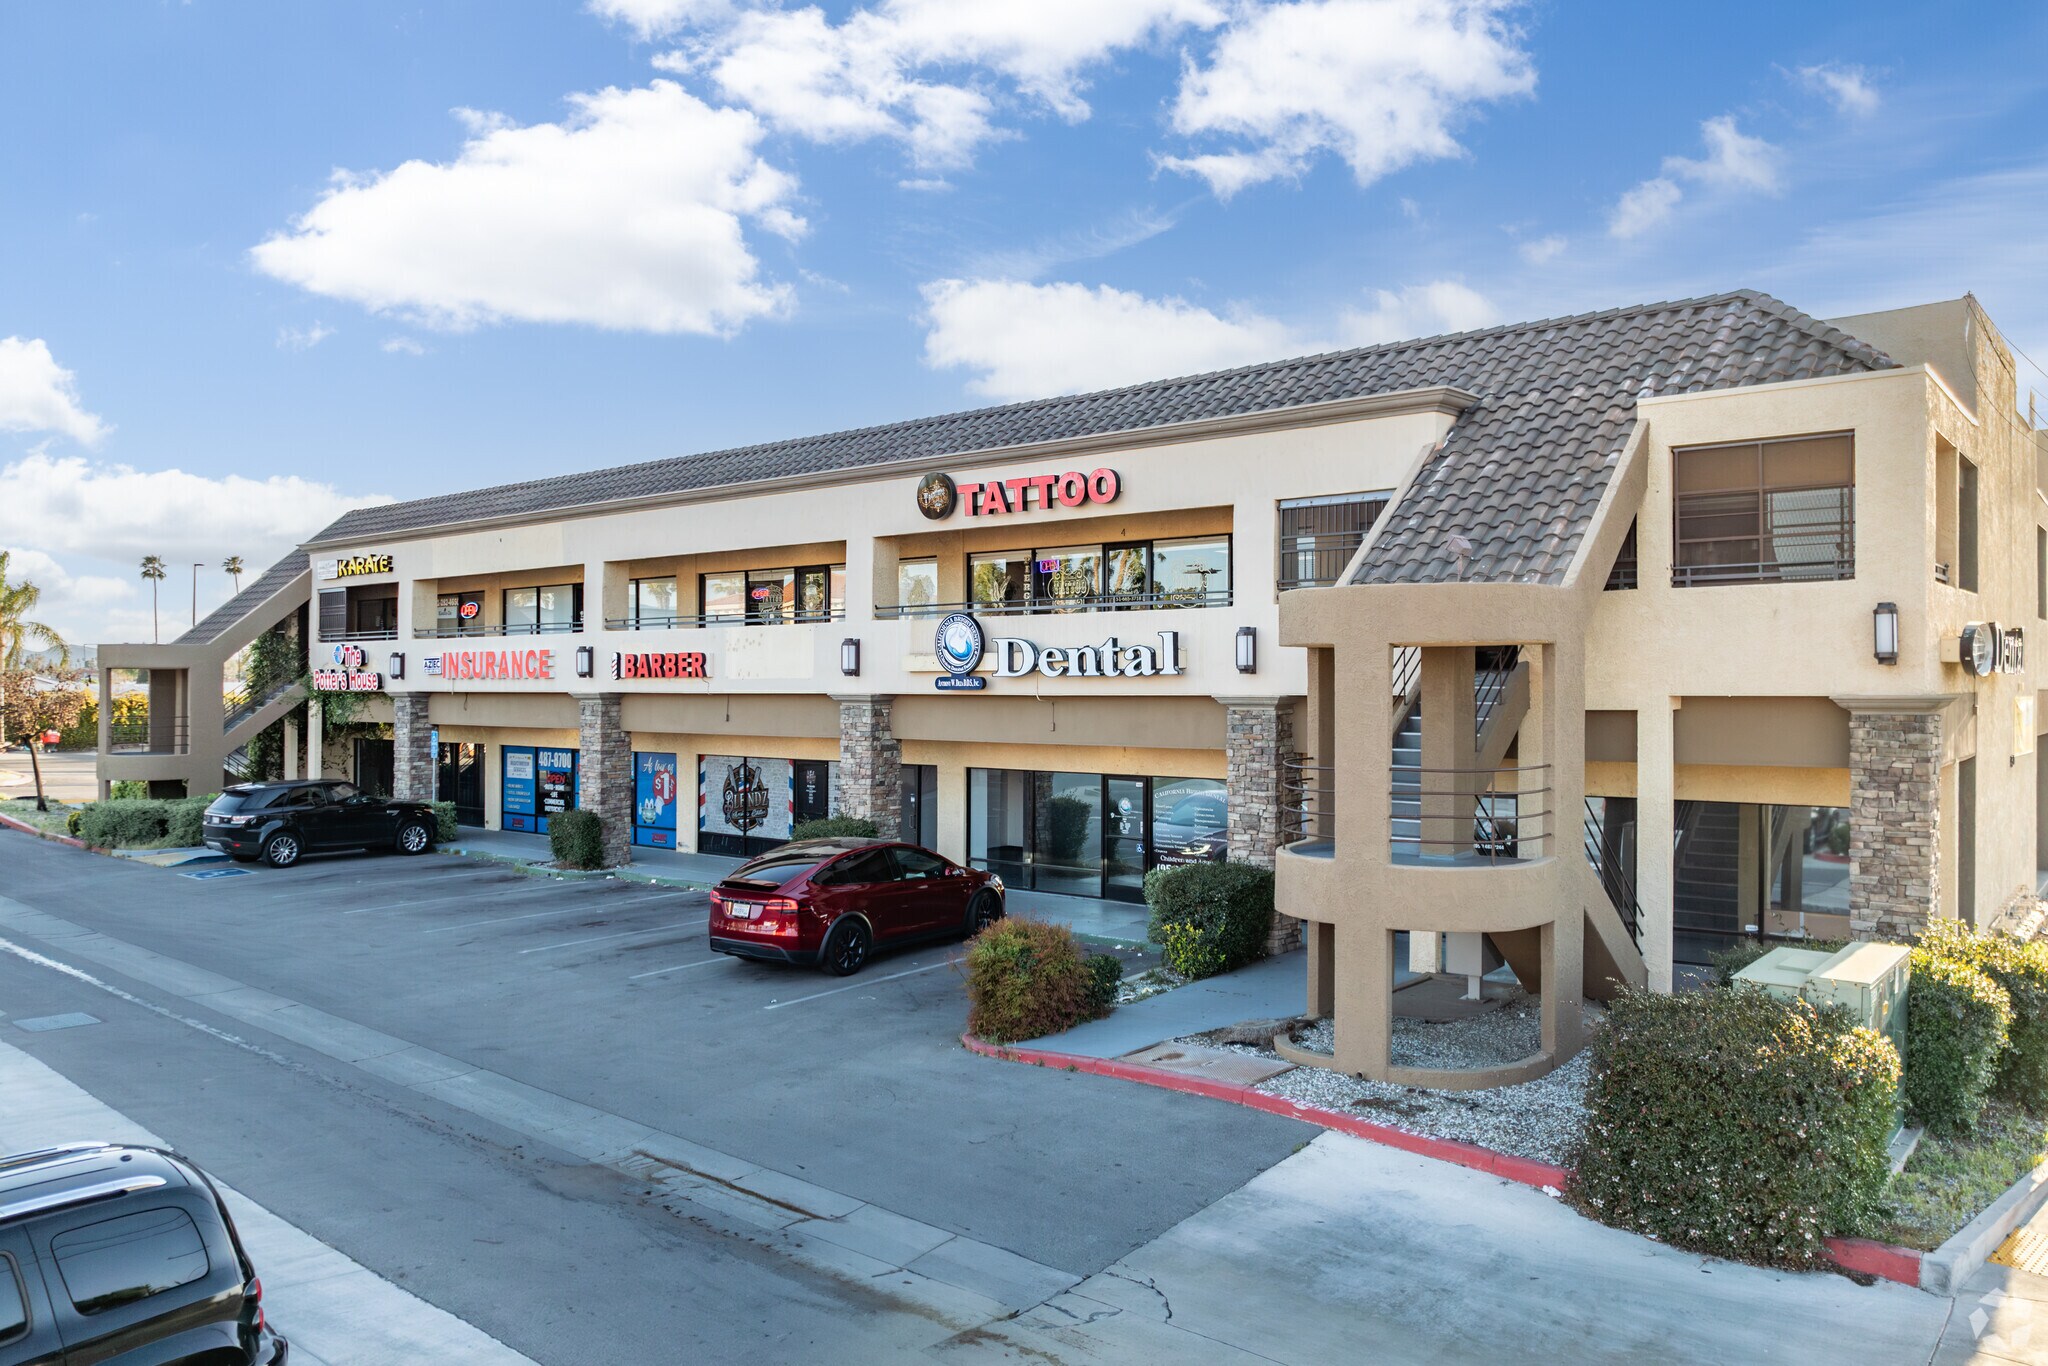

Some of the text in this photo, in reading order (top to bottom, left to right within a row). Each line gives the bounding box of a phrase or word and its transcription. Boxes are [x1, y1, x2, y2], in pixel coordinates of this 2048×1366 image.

[957, 468, 1119, 517] TATTOO
[1121, 528, 1126, 537] 4
[338, 554, 391, 577] KARATE
[1041, 560, 1059, 572] OPEN
[461, 603, 477, 616] OPEN
[344, 646, 361, 667] The
[442, 649, 551, 679] INSURANCE
[992, 631, 1183, 677] Dental
[625, 652, 706, 678] BARBER
[314, 668, 378, 690] Potter's House
[538, 751, 572, 768] 487-8700
[546, 773, 566, 784] OPEN
[724, 790, 768, 812] BLENDZ
[1154, 788, 1186, 799] CALIFORNIA
[1160, 855, 1183, 863] Children
[1185, 856, 1197, 864] and
[1280, 1095, 1339, 1114] PARKING
[1356, 1117, 1388, 1127] FIRE
[1399, 1129, 1439, 1140] LANE
